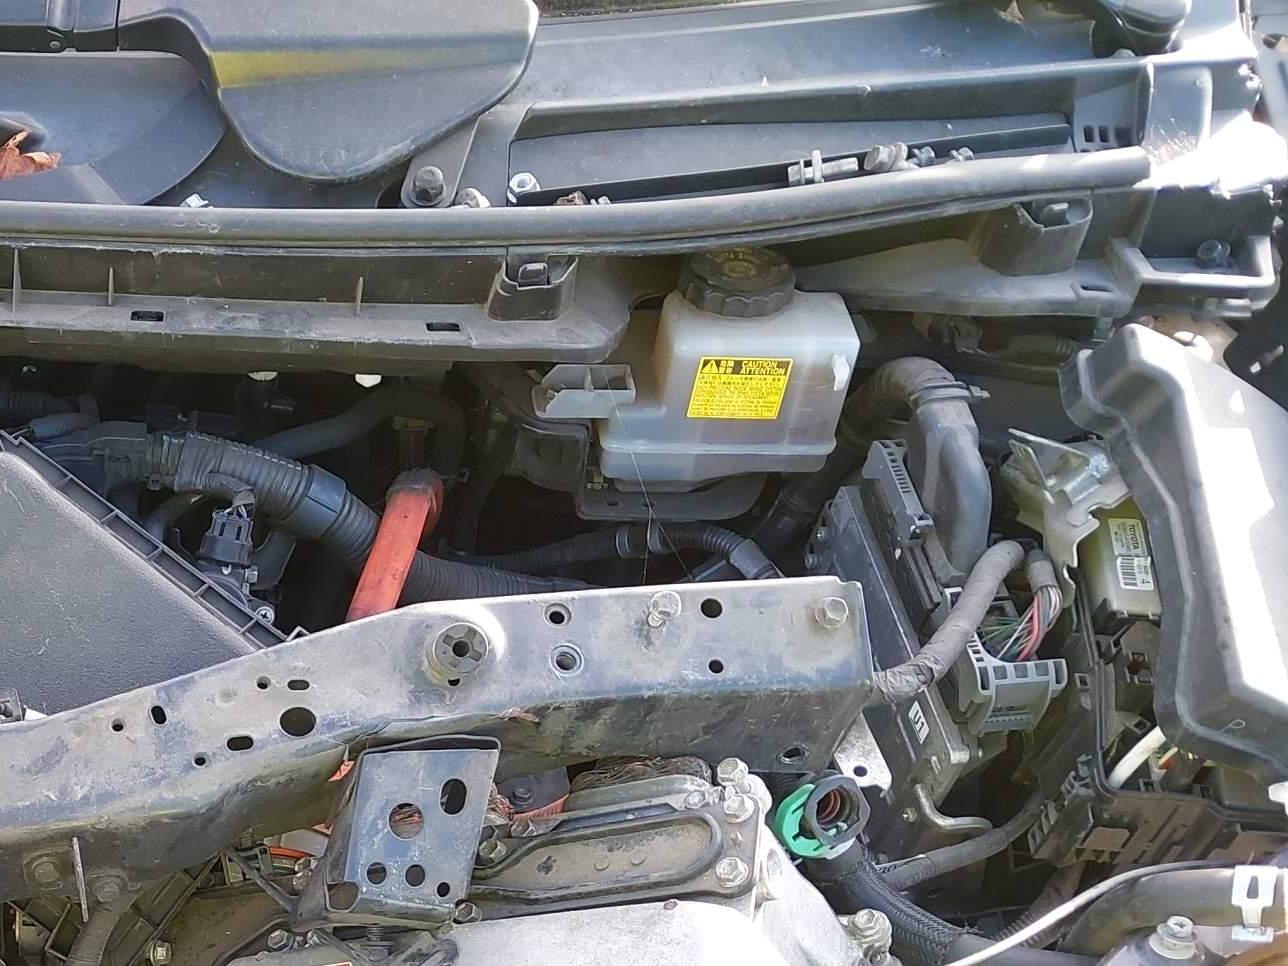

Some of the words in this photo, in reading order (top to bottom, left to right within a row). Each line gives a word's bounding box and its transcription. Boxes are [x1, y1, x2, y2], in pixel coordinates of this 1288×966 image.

[739, 367, 785, 375] ATTENTION
[741, 360, 778, 368] CAUTION
[1128, 524, 1140, 550] TOYOTA
[914, 709, 925, 734] U1
